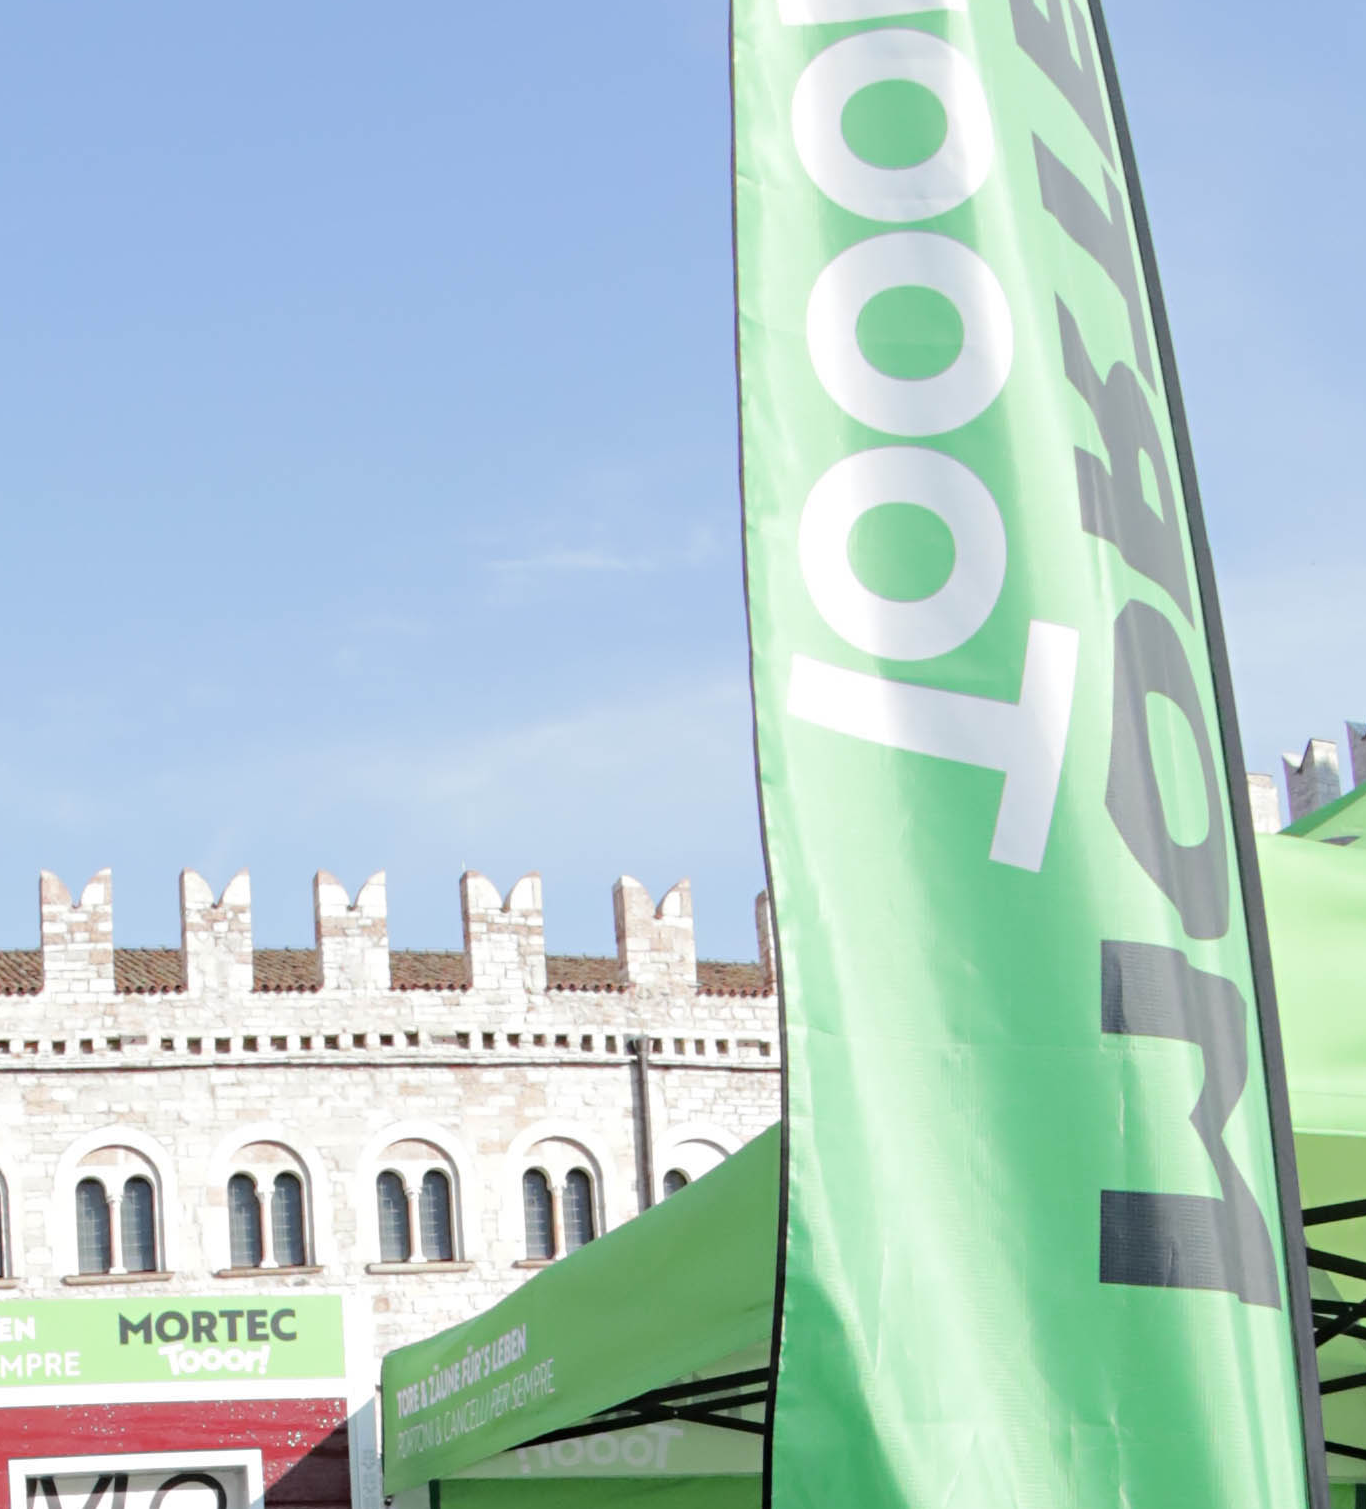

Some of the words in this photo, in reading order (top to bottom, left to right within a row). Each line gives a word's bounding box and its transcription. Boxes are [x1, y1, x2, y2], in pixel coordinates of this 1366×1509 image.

[119, 1308, 297, 1345] MORTEC
[158, 1342, 271, 1376] Tooor!
[397, 1383, 420, 1419] TORE
[428, 1363, 460, 1405] ZÄUNE
[492, 1323, 527, 1371] LEBEN
[512, 1357, 556, 1410] SEMPRE
